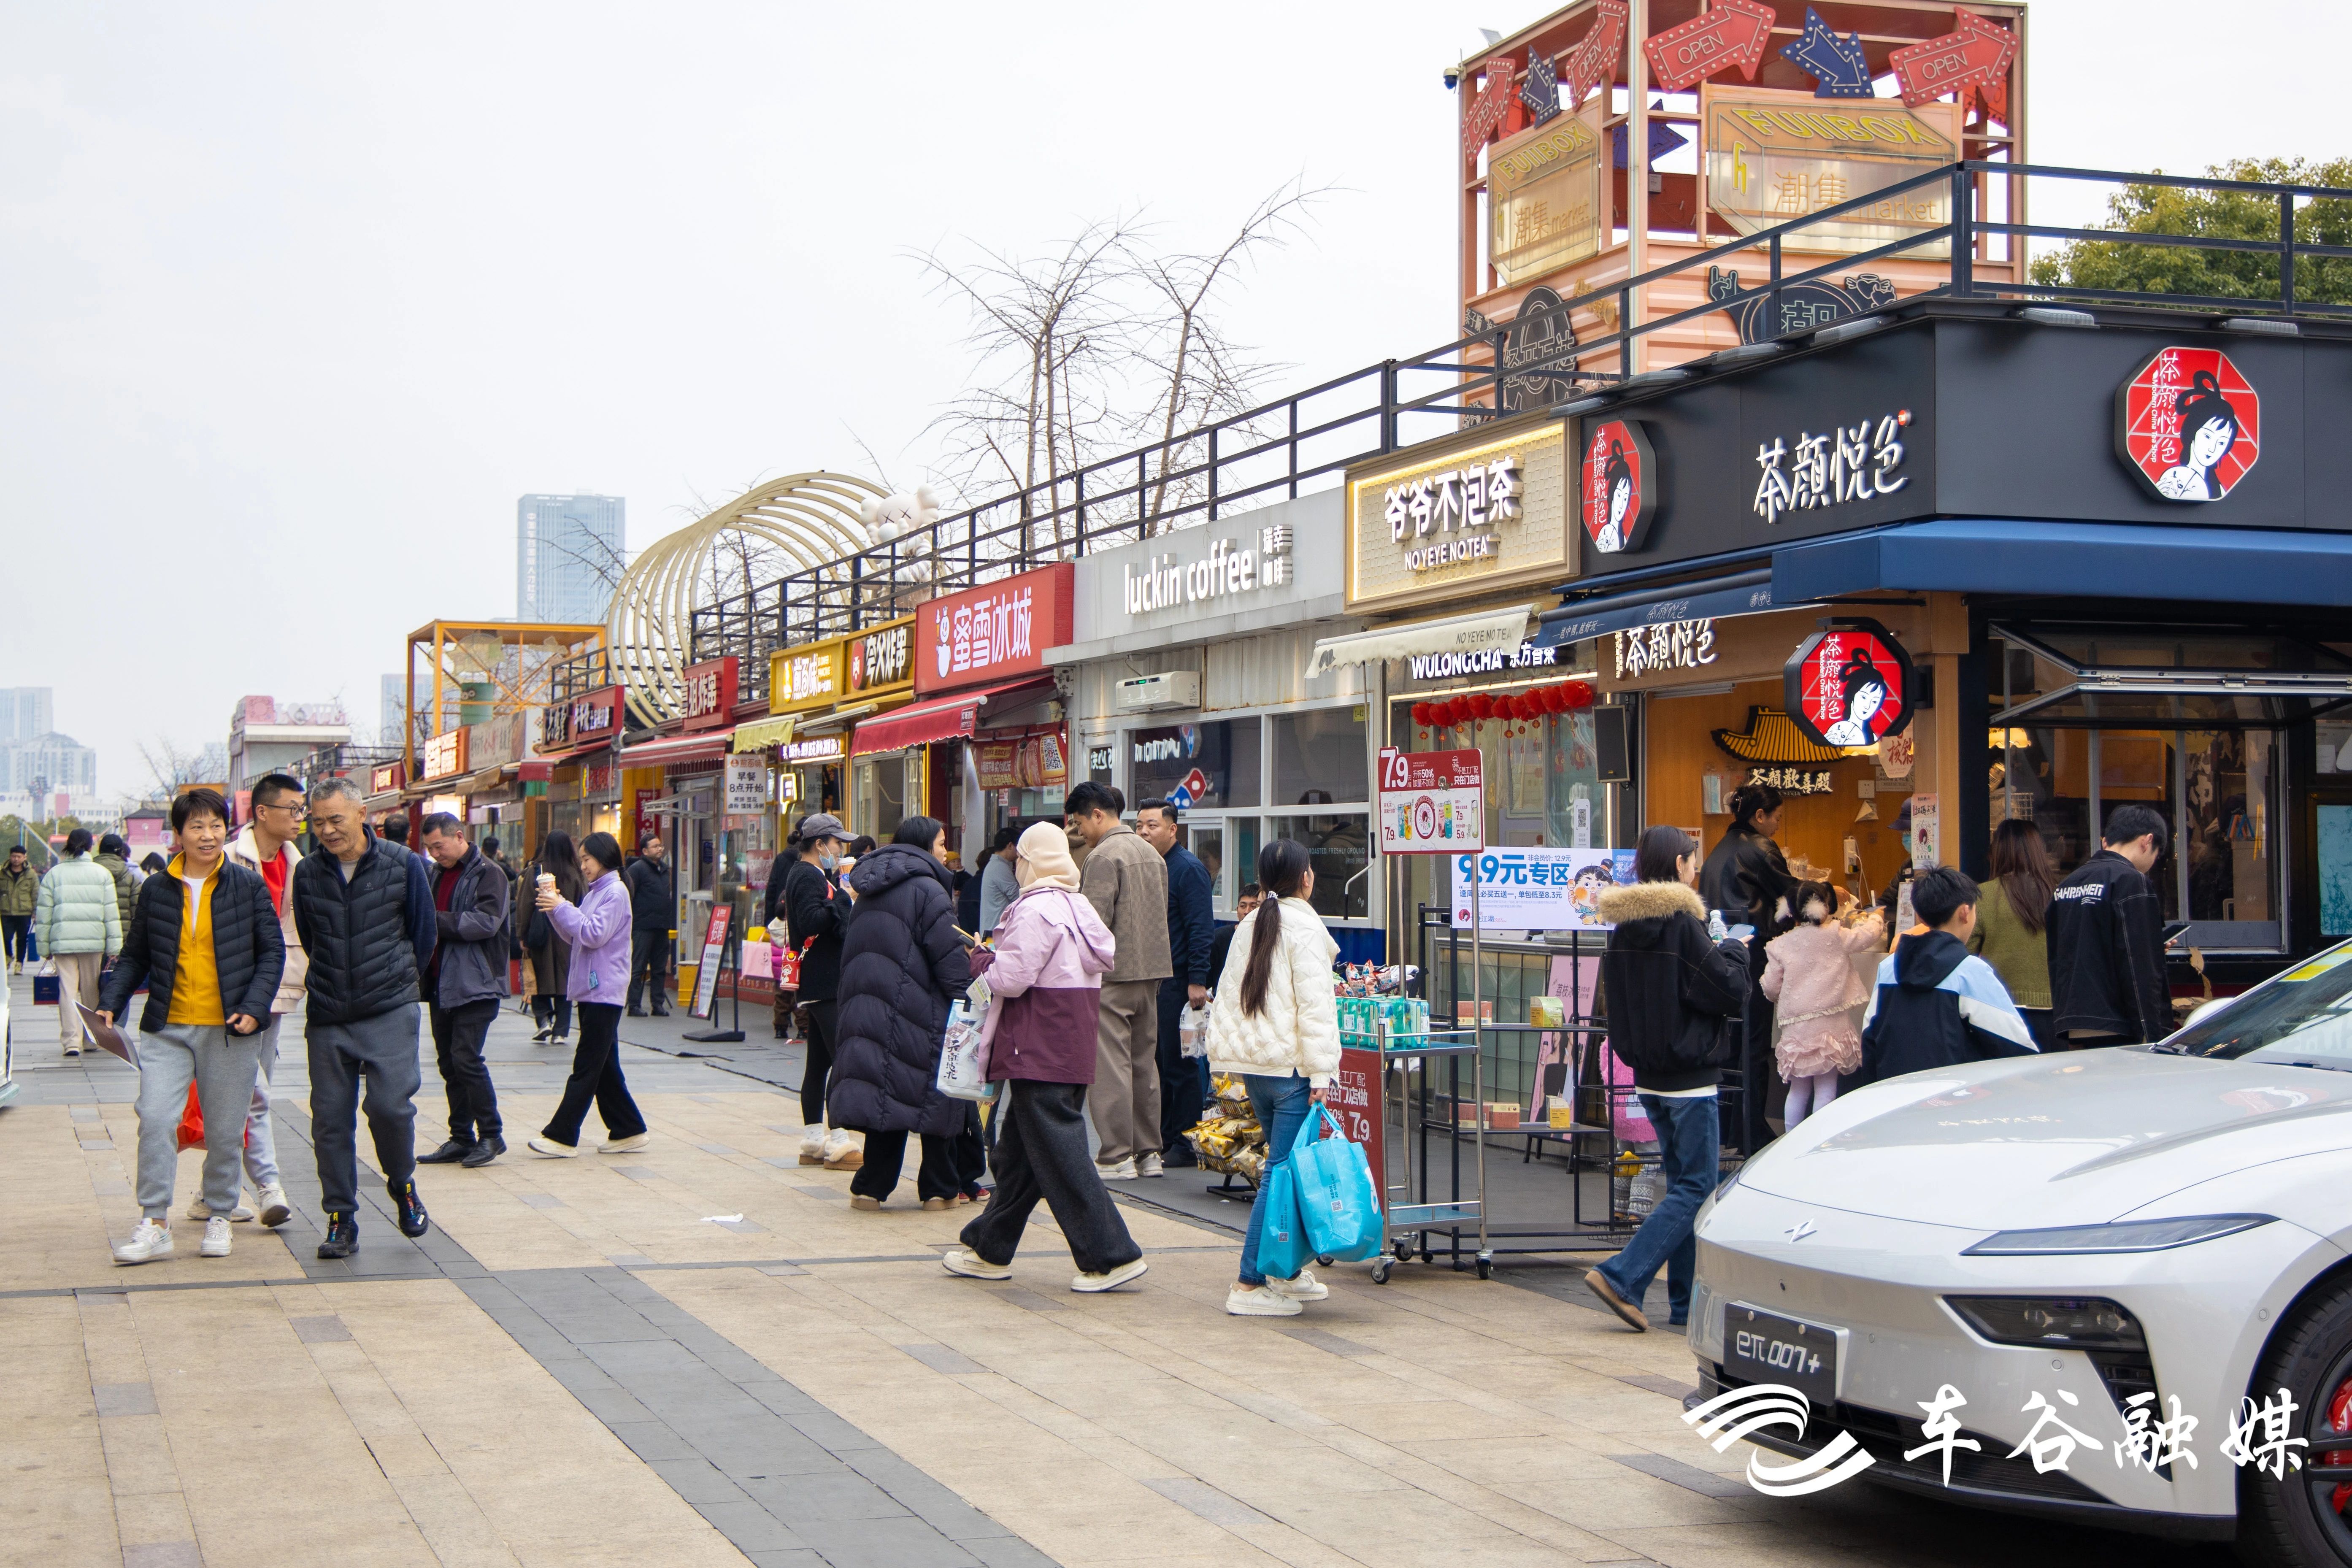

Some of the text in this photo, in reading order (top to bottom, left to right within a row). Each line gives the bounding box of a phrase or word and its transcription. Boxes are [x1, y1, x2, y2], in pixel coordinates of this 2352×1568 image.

[1577, 38, 1603, 78] OPEN
[1678, 30, 1724, 66] OPEN
[1922, 50, 1968, 79] OPEN
[1473, 95, 1493, 134] OPEN
[1384, 455, 1514, 543] 爷爷不泡茶
[1263, 524, 1283, 554] 瑞幸
[1405, 537, 1488, 571] NO YEYE NO TEA
[1125, 539, 1252, 614] luckin coffee
[1263, 556, 1283, 586] 咖啡
[953, 587, 1032, 672] 蜜雪冰城
[1456, 628, 1511, 645] NO YEYE NO TEA
[866, 627, 906, 684] 夸父炸串
[1411, 649, 1503, 679] WULONGCHA
[738, 772, 756, 781] 早餐
[1381, 749, 1408, 788] 7.9
[1412, 779, 1435, 787] 加量不加价
[1454, 775, 1480, 785] 只在门店做
[1457, 766, 1479, 775] 不是工厂配
[730, 783, 764, 792] 8点开始
[1385, 827, 1394, 841] 7.9
[710, 920, 726, 944] 招聘
[1327, 1084, 1368, 1107] 在门店做
[1349, 1111, 1370, 1141] 7.9
